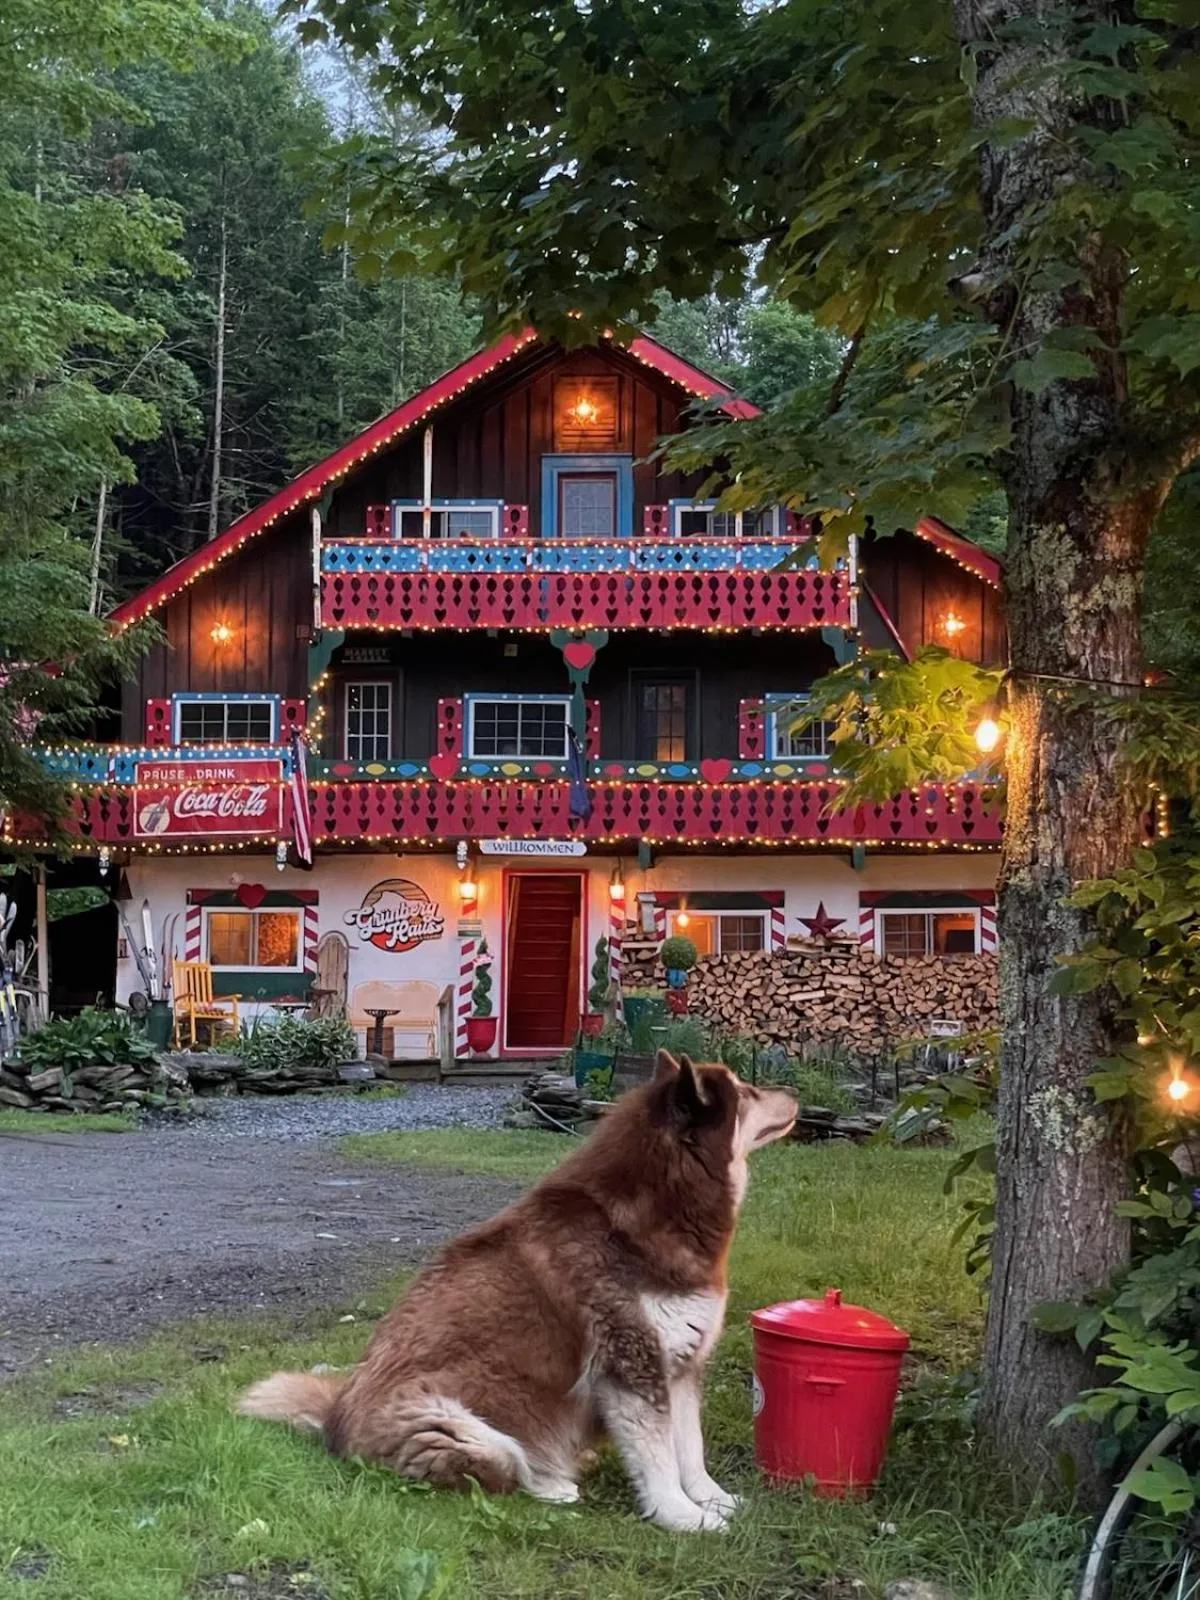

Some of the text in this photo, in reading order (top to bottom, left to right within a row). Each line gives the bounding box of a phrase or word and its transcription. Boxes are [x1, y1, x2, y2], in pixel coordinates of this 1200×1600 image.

[196, 768, 236, 779] DRINK
[174, 784, 270, 818] Coca-Cola
[385, 921, 444, 948] Haus
